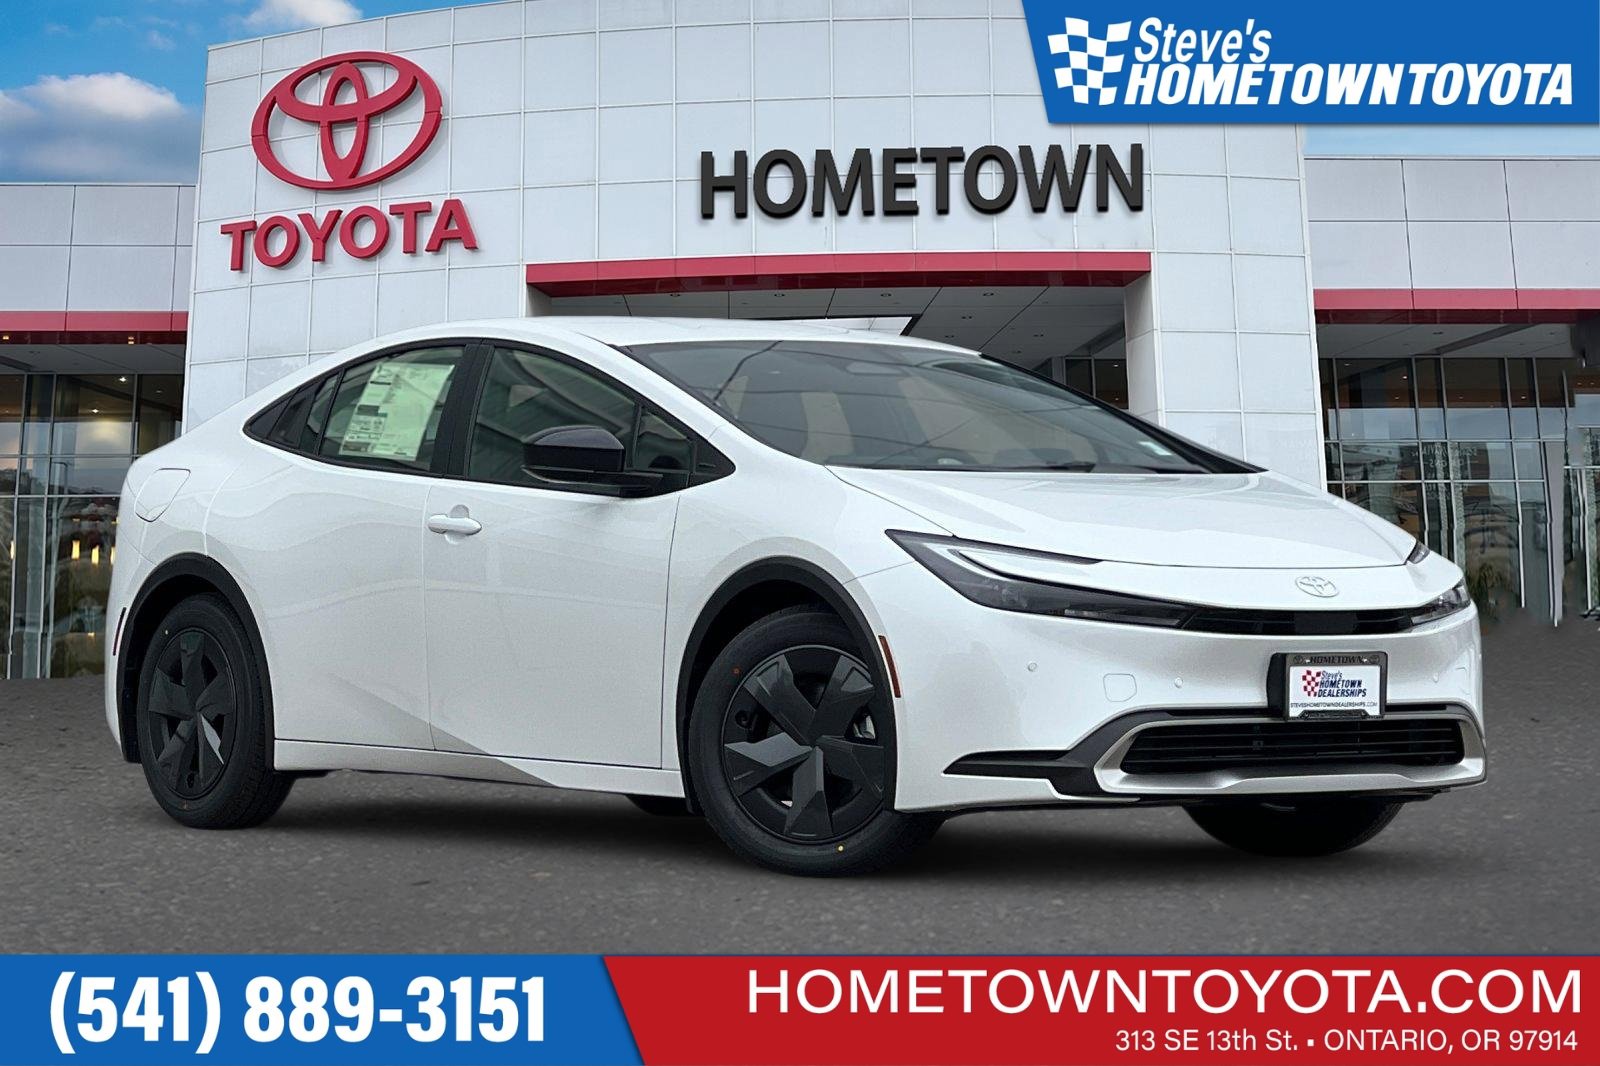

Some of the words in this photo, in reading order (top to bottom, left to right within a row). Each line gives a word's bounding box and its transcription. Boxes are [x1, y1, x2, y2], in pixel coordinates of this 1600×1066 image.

[700, 143, 1144, 219] HOMETOWN
[220, 198, 478, 271] TOYOTA
[1309, 655, 1363, 664] HOMETOWN
[1321, 670, 1343, 681] Steve's
[1319, 680, 1363, 688] HOMETOWN
[1317, 688, 1367, 697] DEALERSHIPS
